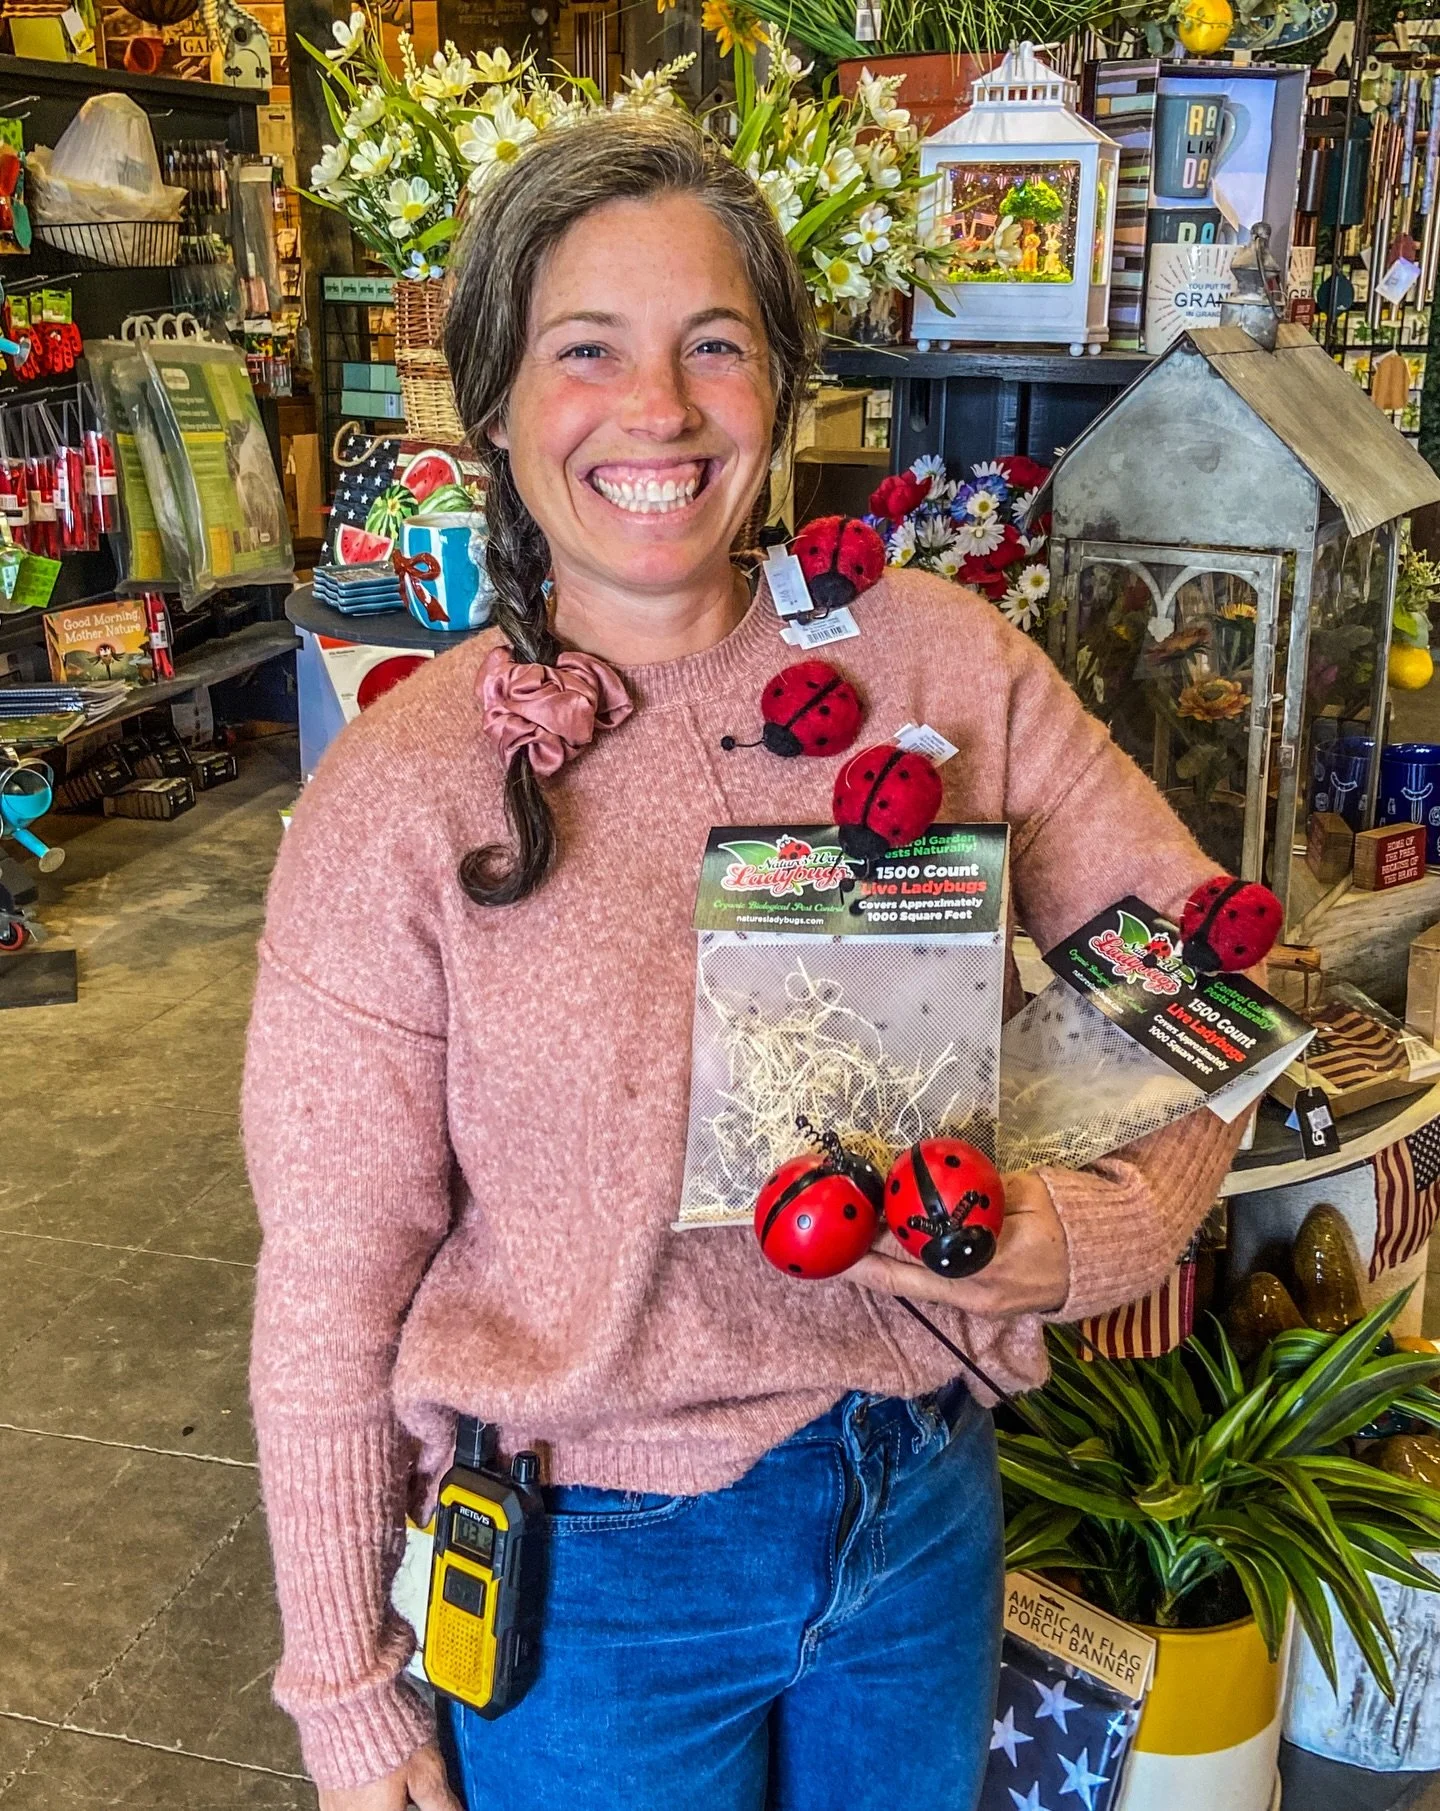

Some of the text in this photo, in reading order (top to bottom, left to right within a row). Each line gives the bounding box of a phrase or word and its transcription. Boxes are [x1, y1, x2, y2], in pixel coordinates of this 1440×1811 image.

[63, 616, 91, 631] Good
[65, 623, 140, 644] Mother Nature
[929, 834, 976, 845] Garden
[884, 842, 977, 859] ests Naturally!
[727, 864, 848, 893] Ladybugs
[876, 863, 979, 879] 1500 Count
[861, 880, 987, 896] Live Ladybugs
[714, 901, 745, 911] Organic
[748, 901, 790, 913] Biological
[814, 903, 846, 913] Control
[859, 897, 983, 910] Covers Approximately
[736, 915, 824, 926] naturesladybugs.com
[867, 910, 973, 922] 1000 Square Feet
[1213, 981, 1251, 1003] Control
[1203, 987, 1276, 1031] Pests Naturally!
[1166, 1002, 1247, 1063] Live Ladybugs
[1188, 998, 1257, 1049] 1500 Count
[1148, 1025, 1213, 1075] 1000 Square Feet
[1153, 1014, 1230, 1071] Covers Approximately
[1008, 1590, 1095, 1645] AMERICAN
[1100, 1637, 1142, 1671] FLAG
[1008, 1605, 1064, 1645] PORCH
[1068, 1637, 1135, 1684] BANNER
